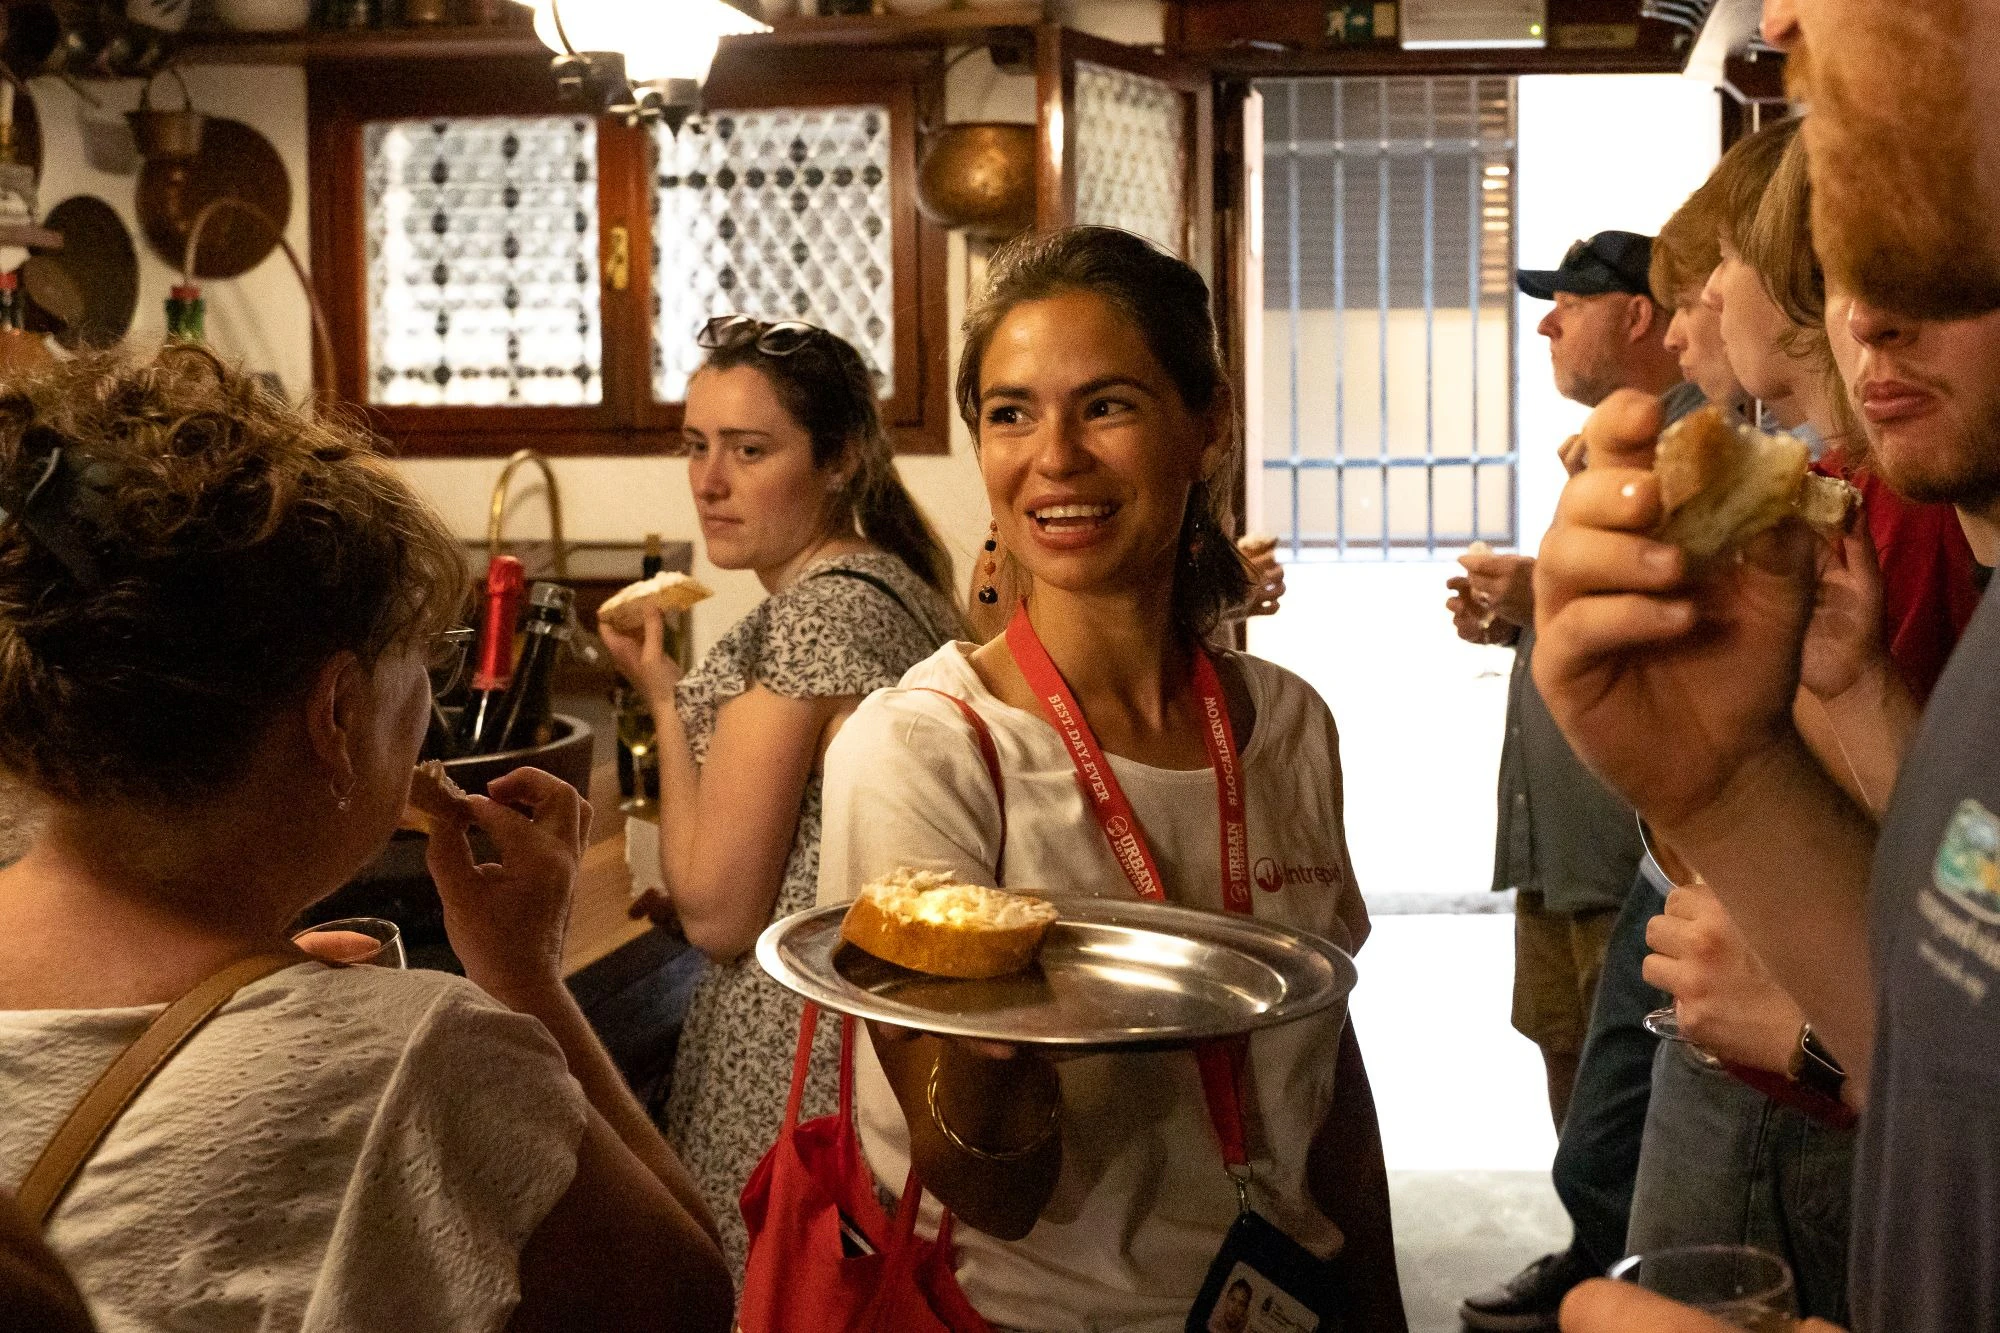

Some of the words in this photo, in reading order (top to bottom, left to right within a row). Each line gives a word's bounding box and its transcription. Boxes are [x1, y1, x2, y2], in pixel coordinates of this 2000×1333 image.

[1204, 697, 1237, 806] #LOCALSKNOW
[1120, 833, 1156, 895] URBAN
[1227, 821, 1241, 882] URBAN
